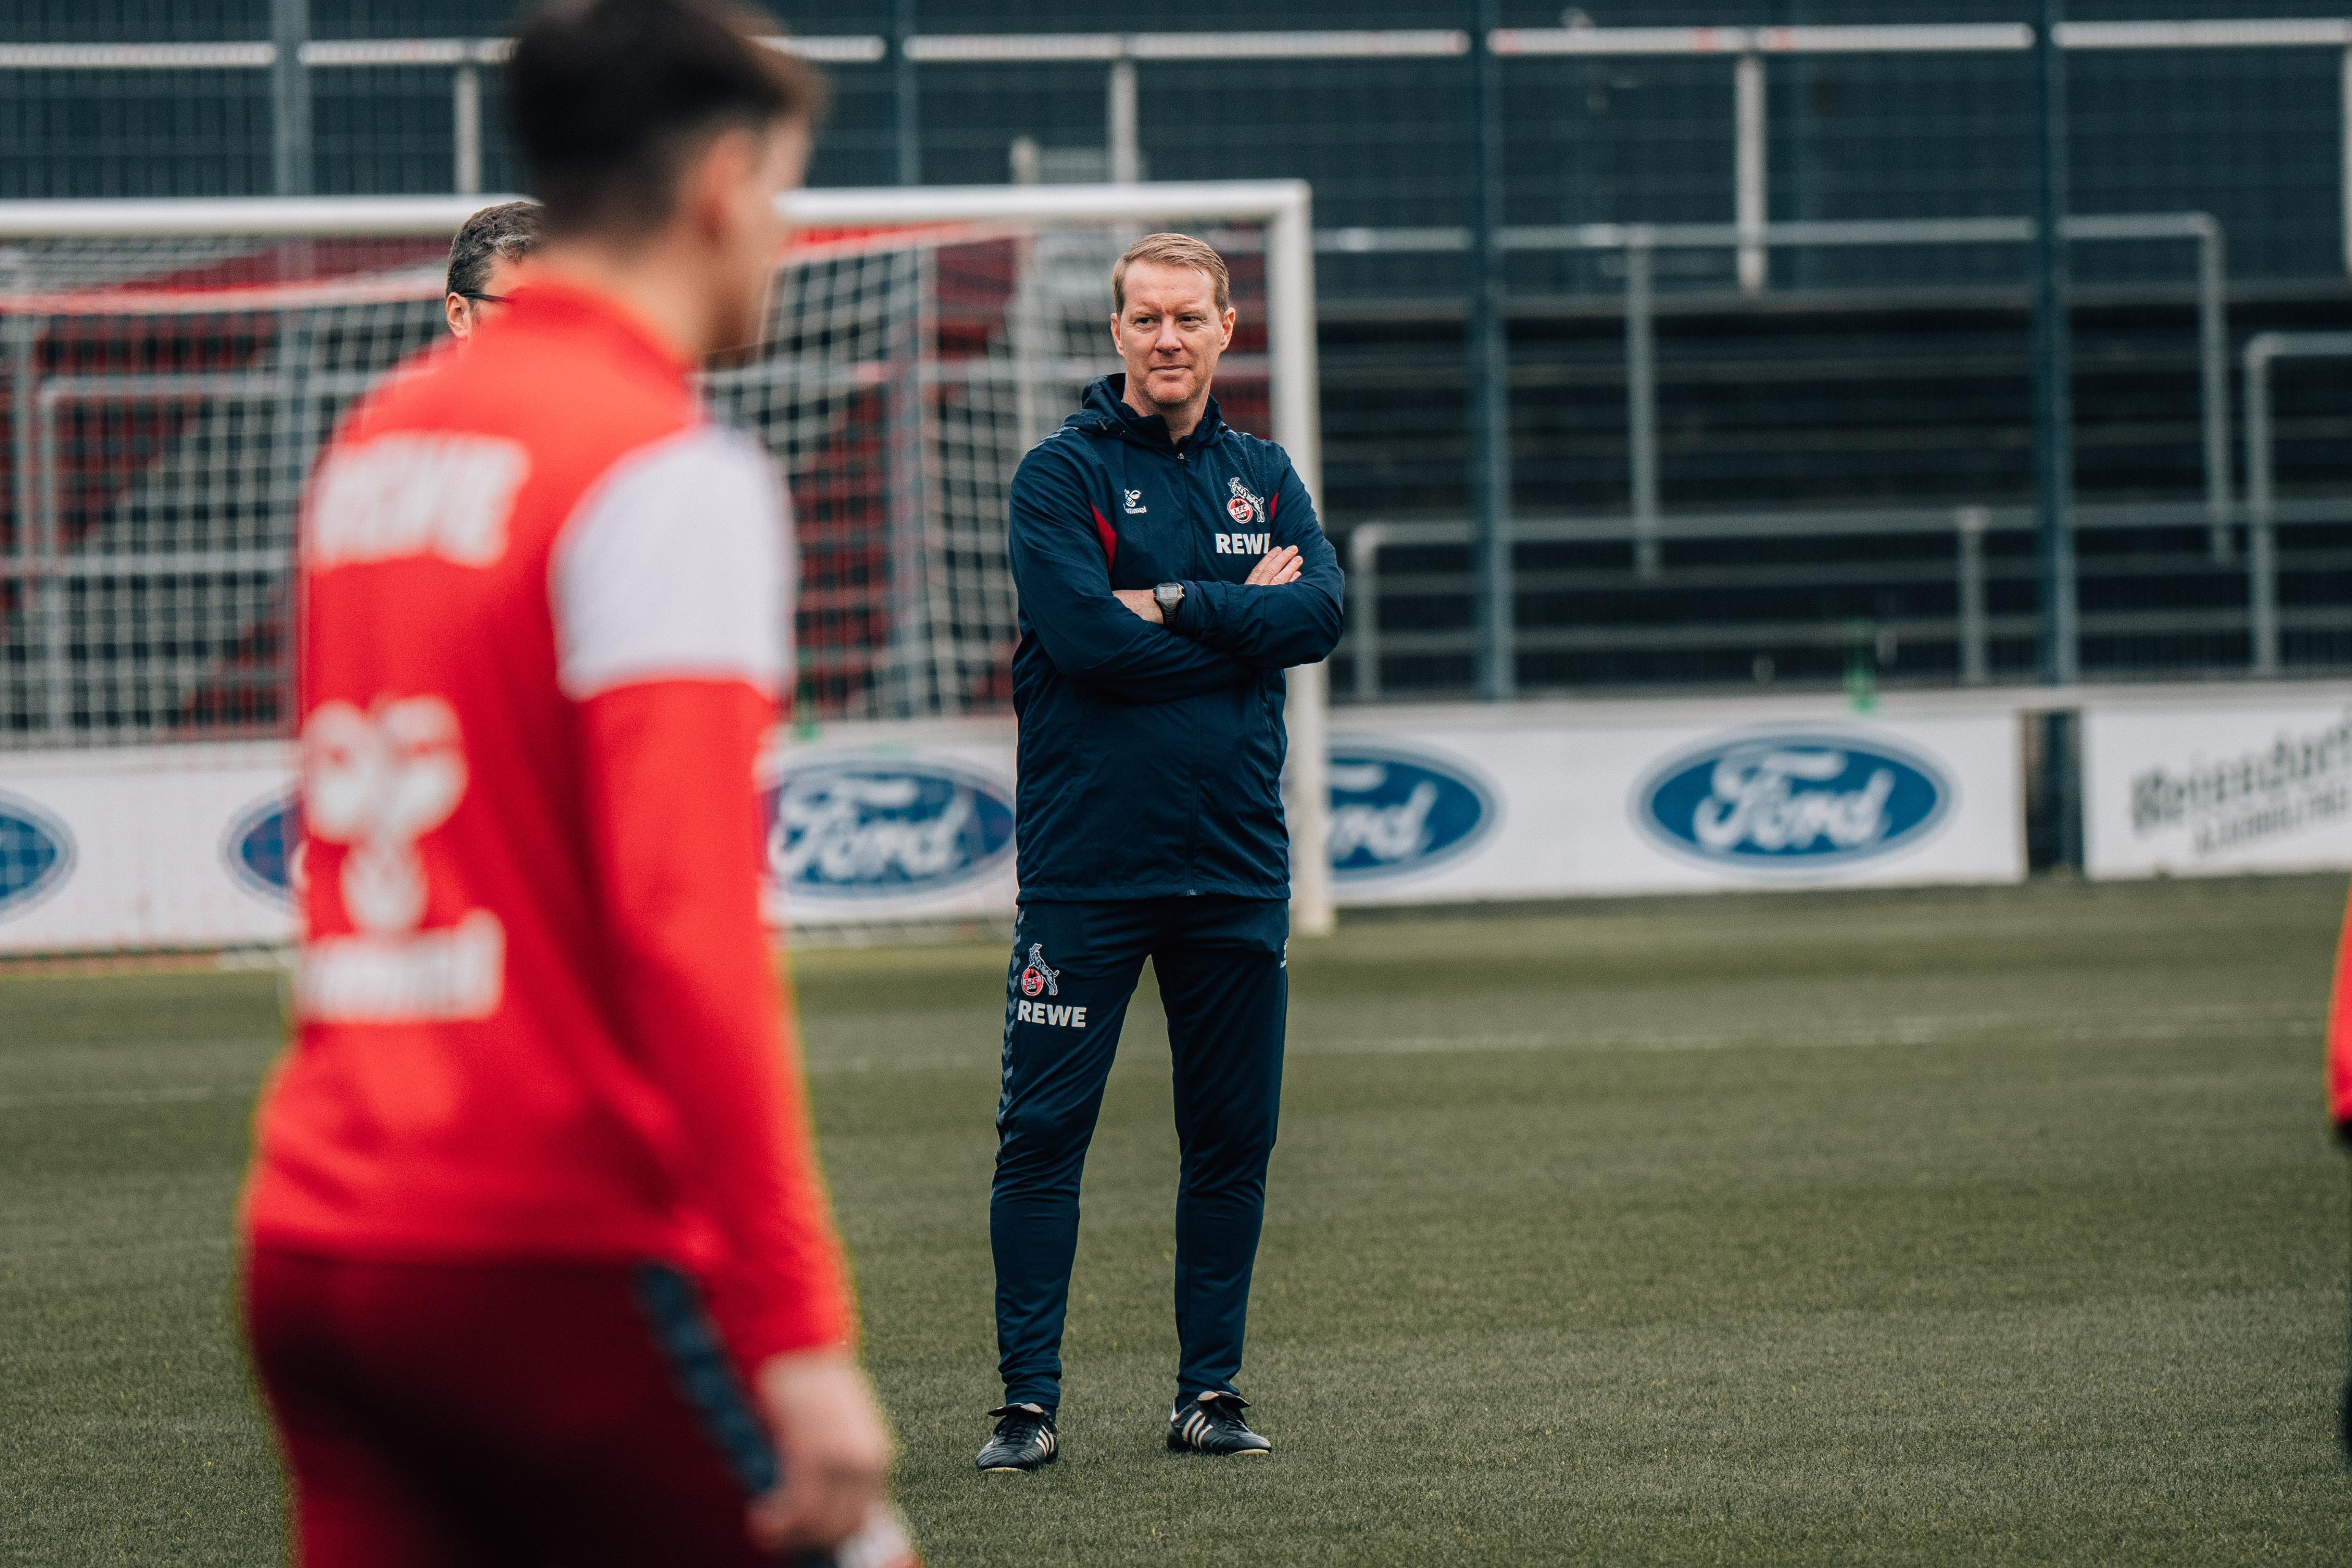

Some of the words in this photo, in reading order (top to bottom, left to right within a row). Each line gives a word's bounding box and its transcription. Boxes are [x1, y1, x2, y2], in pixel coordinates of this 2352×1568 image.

[767, 767, 970, 880] Ford
[1692, 745, 1896, 850] Ford
[1017, 1000, 1087, 1027] REWE
